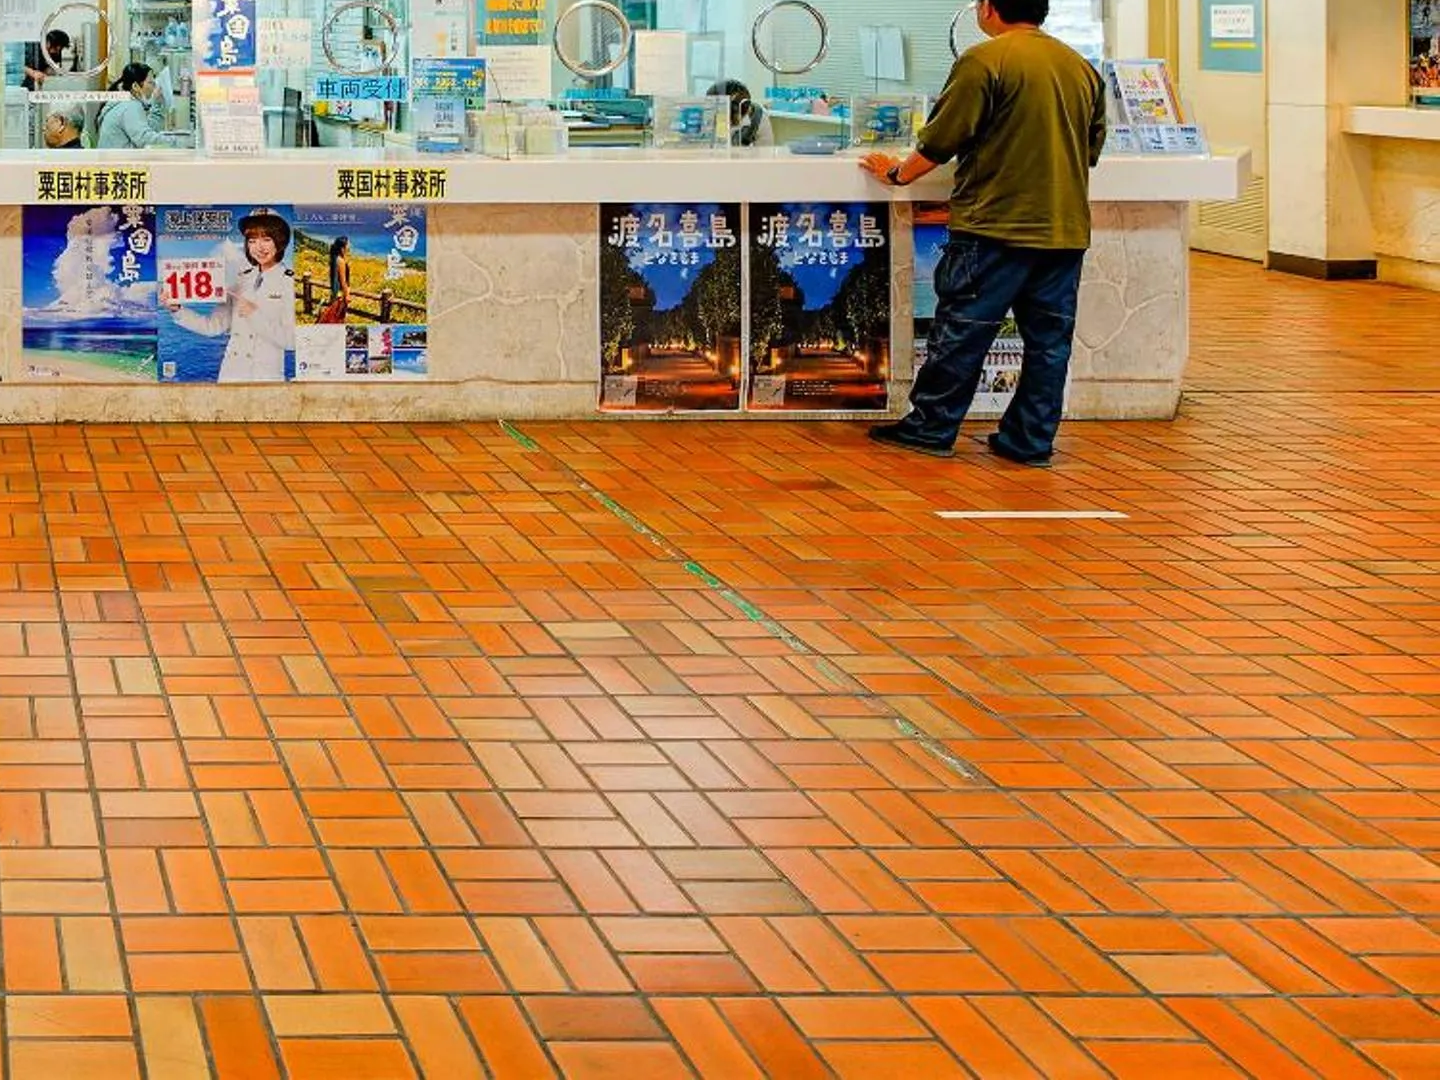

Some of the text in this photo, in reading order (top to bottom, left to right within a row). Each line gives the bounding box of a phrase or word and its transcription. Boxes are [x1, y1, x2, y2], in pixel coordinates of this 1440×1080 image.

[317, 78, 406, 100] 車両受付
[37, 170, 148, 201] 粟国村事務所
[336, 168, 447, 199] 粟国村事務所
[607, 210, 738, 251] 渡名喜島
[757, 209, 887, 251] 渡名喜島
